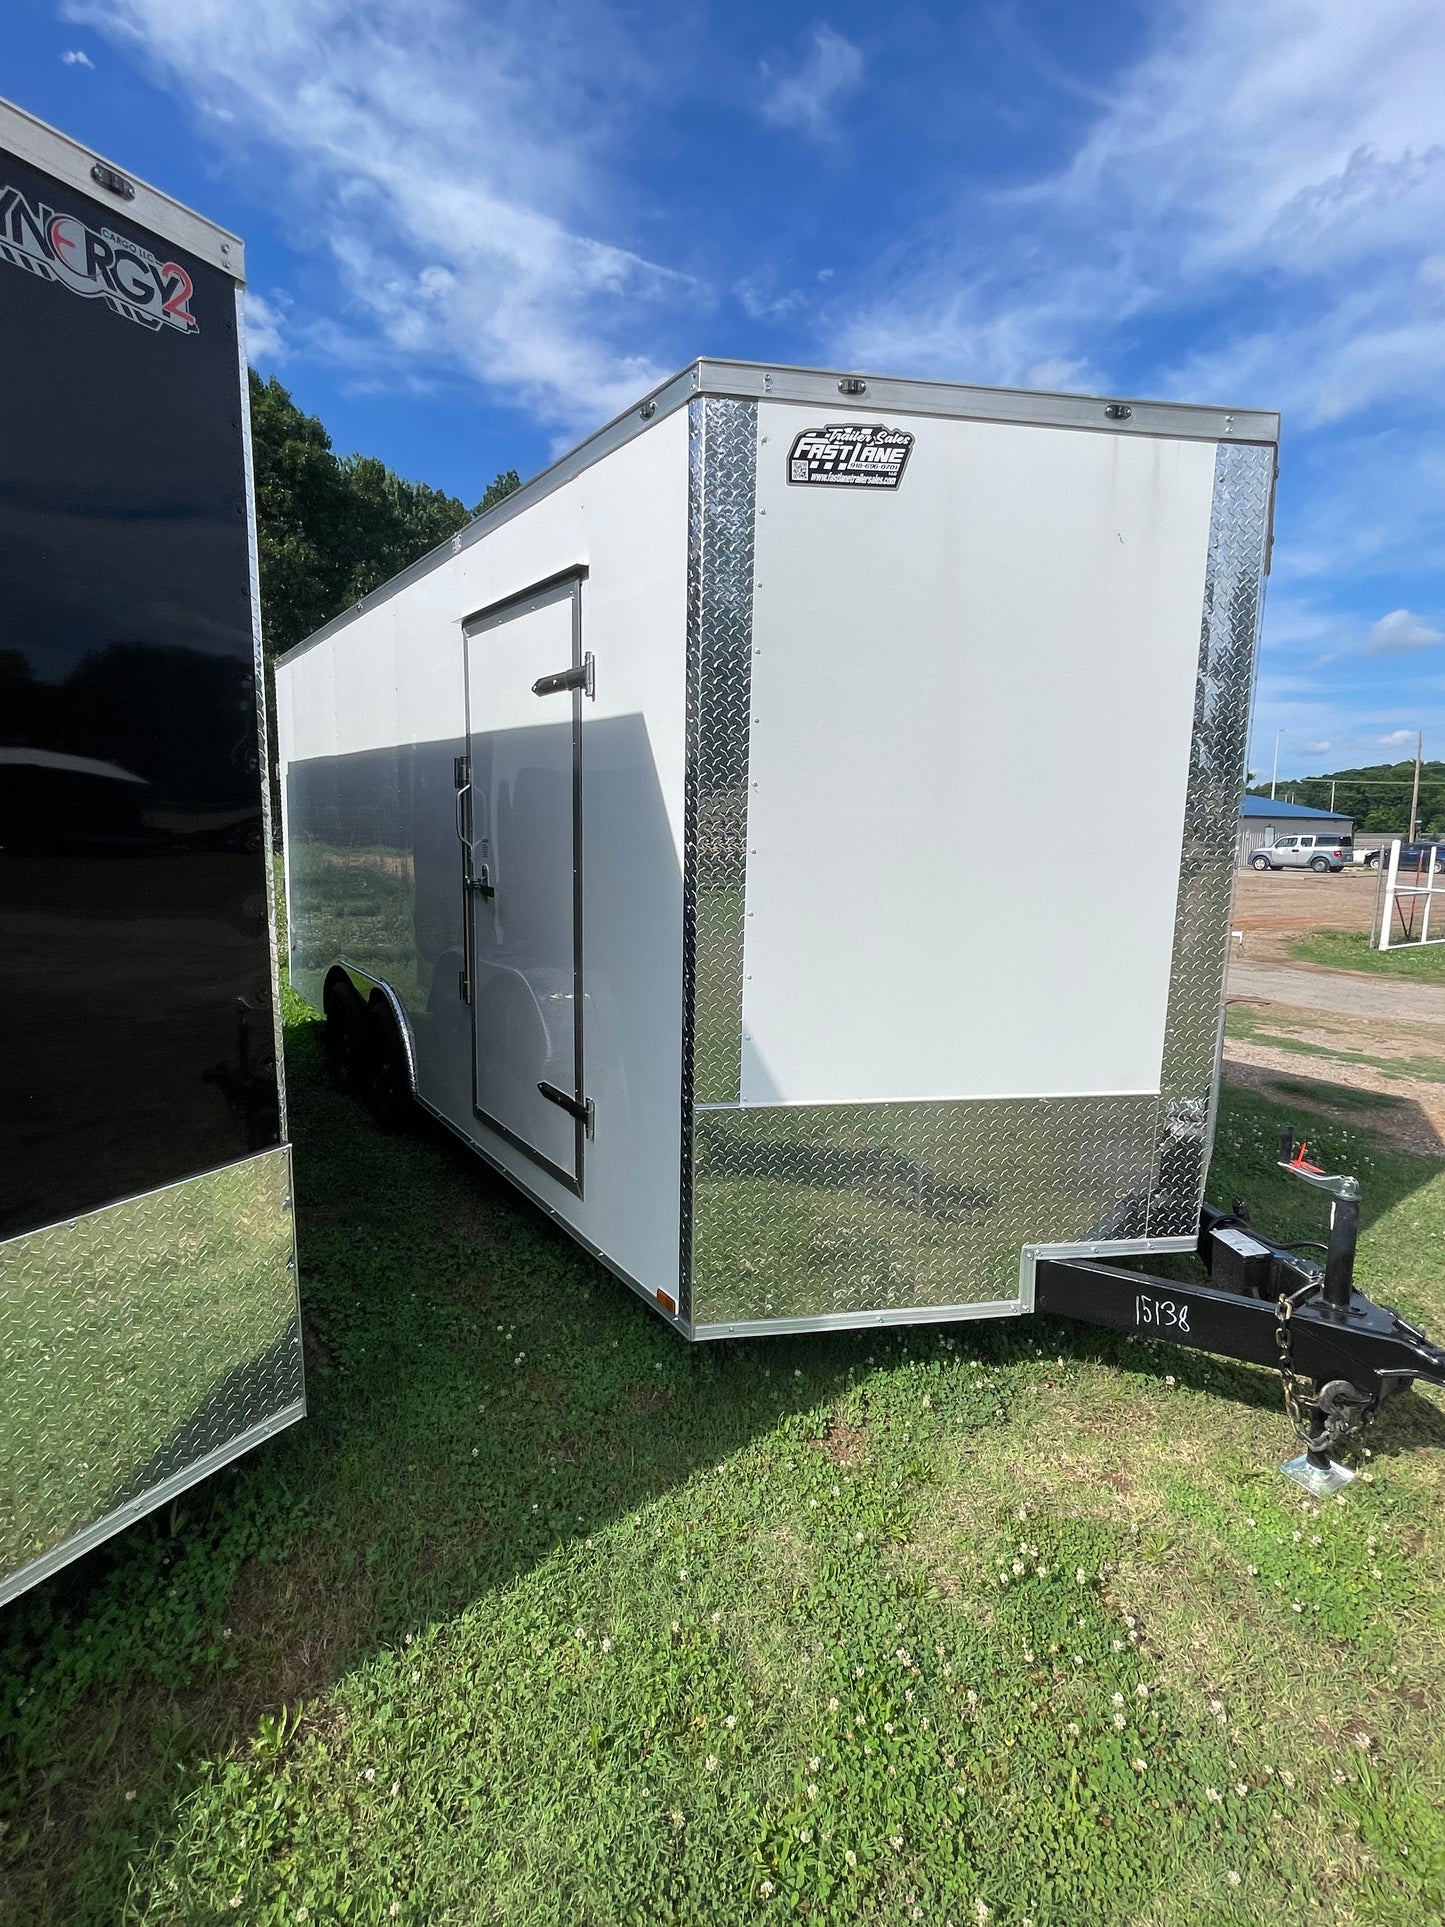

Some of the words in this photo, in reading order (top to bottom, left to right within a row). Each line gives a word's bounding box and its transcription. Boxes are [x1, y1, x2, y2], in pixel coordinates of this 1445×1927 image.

[102, 228, 138, 254] CARGO
[828, 428, 872, 443] Trailer
[874, 431, 911, 445] Sales
[850, 462, 899, 470] 918-696-0701
[1136, 1294, 1190, 1332] 15138
